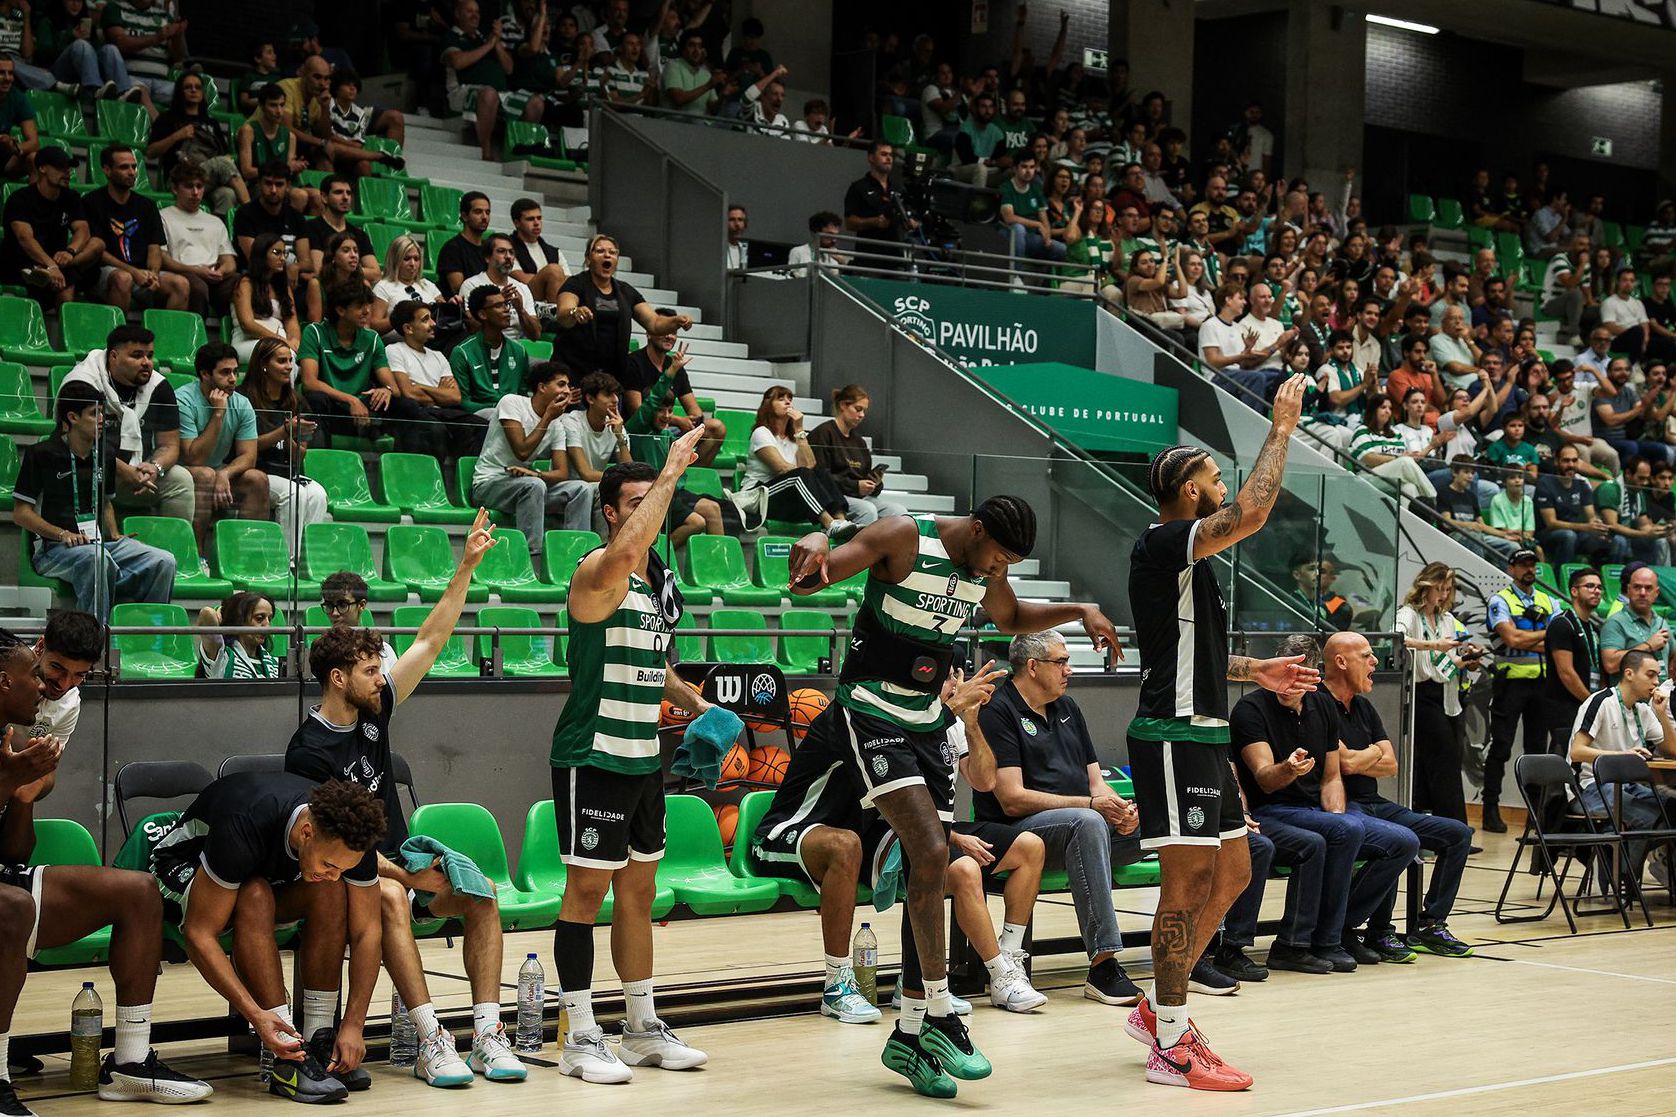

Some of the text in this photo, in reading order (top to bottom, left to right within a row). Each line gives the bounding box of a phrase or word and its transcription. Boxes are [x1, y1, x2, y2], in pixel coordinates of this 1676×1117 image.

[894, 296, 930, 312] SCP
[899, 316, 932, 337] ORTING
[940, 322, 1038, 353] PAVILHÃO
[1073, 408, 1089, 419] DE
[1096, 410, 1164, 424] PORTUGAL
[916, 593, 971, 618] SPORTING
[715, 675, 742, 704] W
[581, 807, 625, 821] FIDELIDADE
